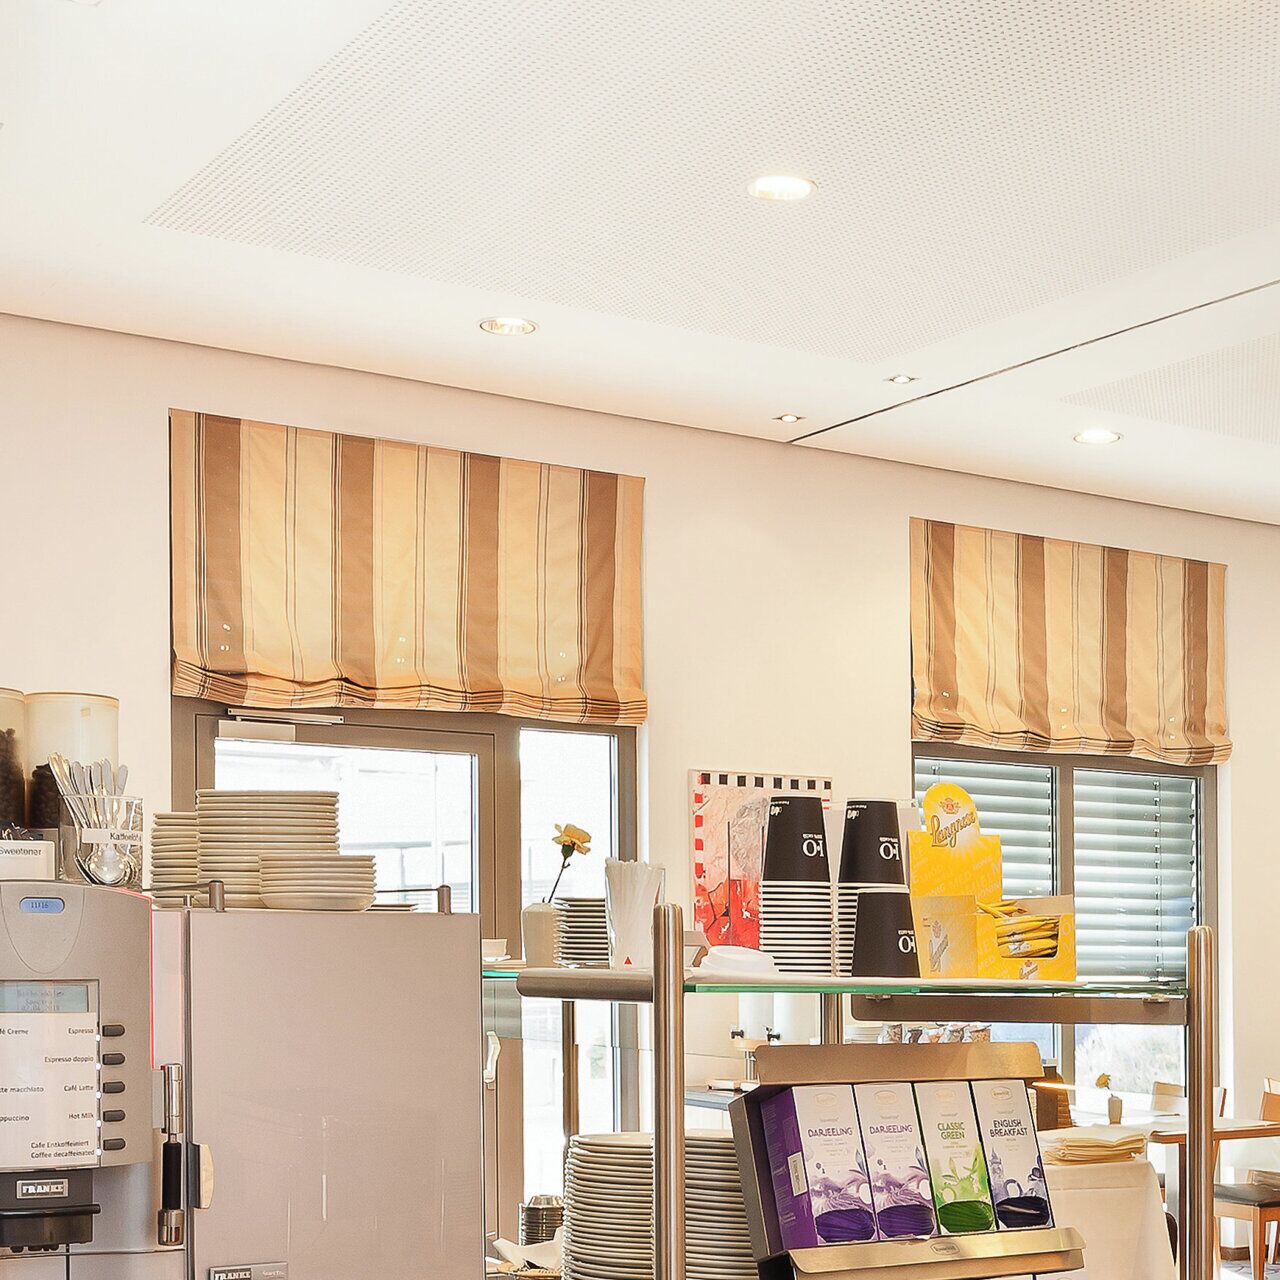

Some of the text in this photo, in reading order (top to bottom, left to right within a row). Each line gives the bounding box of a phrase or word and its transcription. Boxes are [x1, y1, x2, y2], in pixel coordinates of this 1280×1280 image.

[44, 1055, 94, 1064] Espresso doppio
[937, 1121, 966, 1131] CLASSIC
[993, 1119, 1022, 1129] ENGLISH
[808, 1127, 853, 1138] DARJEELING
[869, 1124, 913, 1135] DARJEELING
[989, 1127, 1028, 1138] BREAKFAST
[940, 1131, 965, 1140] GREEN
[22, 1185, 64, 1194] FRANKE
[214, 1271, 251, 1280] FRANKE
